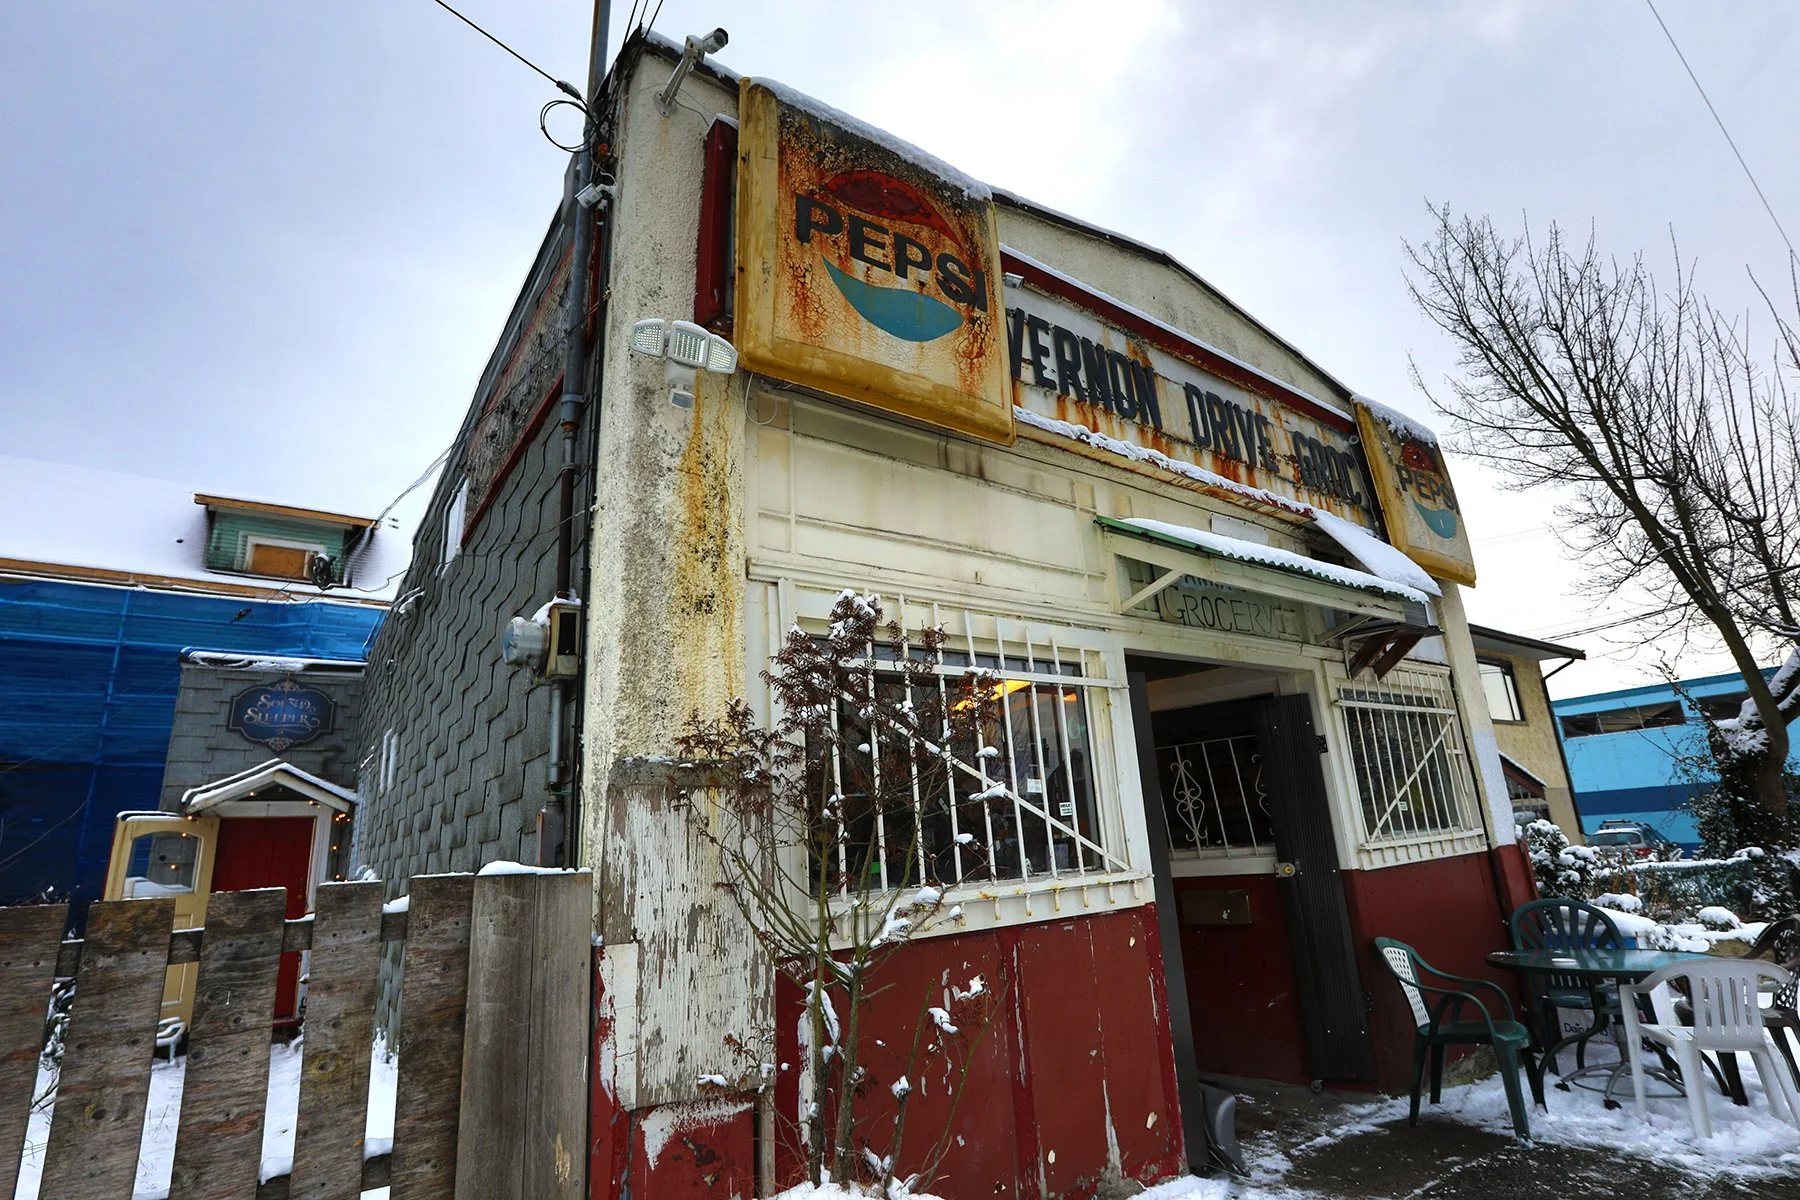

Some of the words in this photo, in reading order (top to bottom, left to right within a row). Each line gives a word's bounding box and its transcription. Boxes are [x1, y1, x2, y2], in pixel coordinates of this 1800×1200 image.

[795, 193, 989, 312] PEPSI
[1006, 307, 1163, 430] VERNON
[1183, 381, 1280, 473] DRIVE
[1291, 431, 1362, 505] GROC
[1162, 585, 1273, 634] GROCERY
